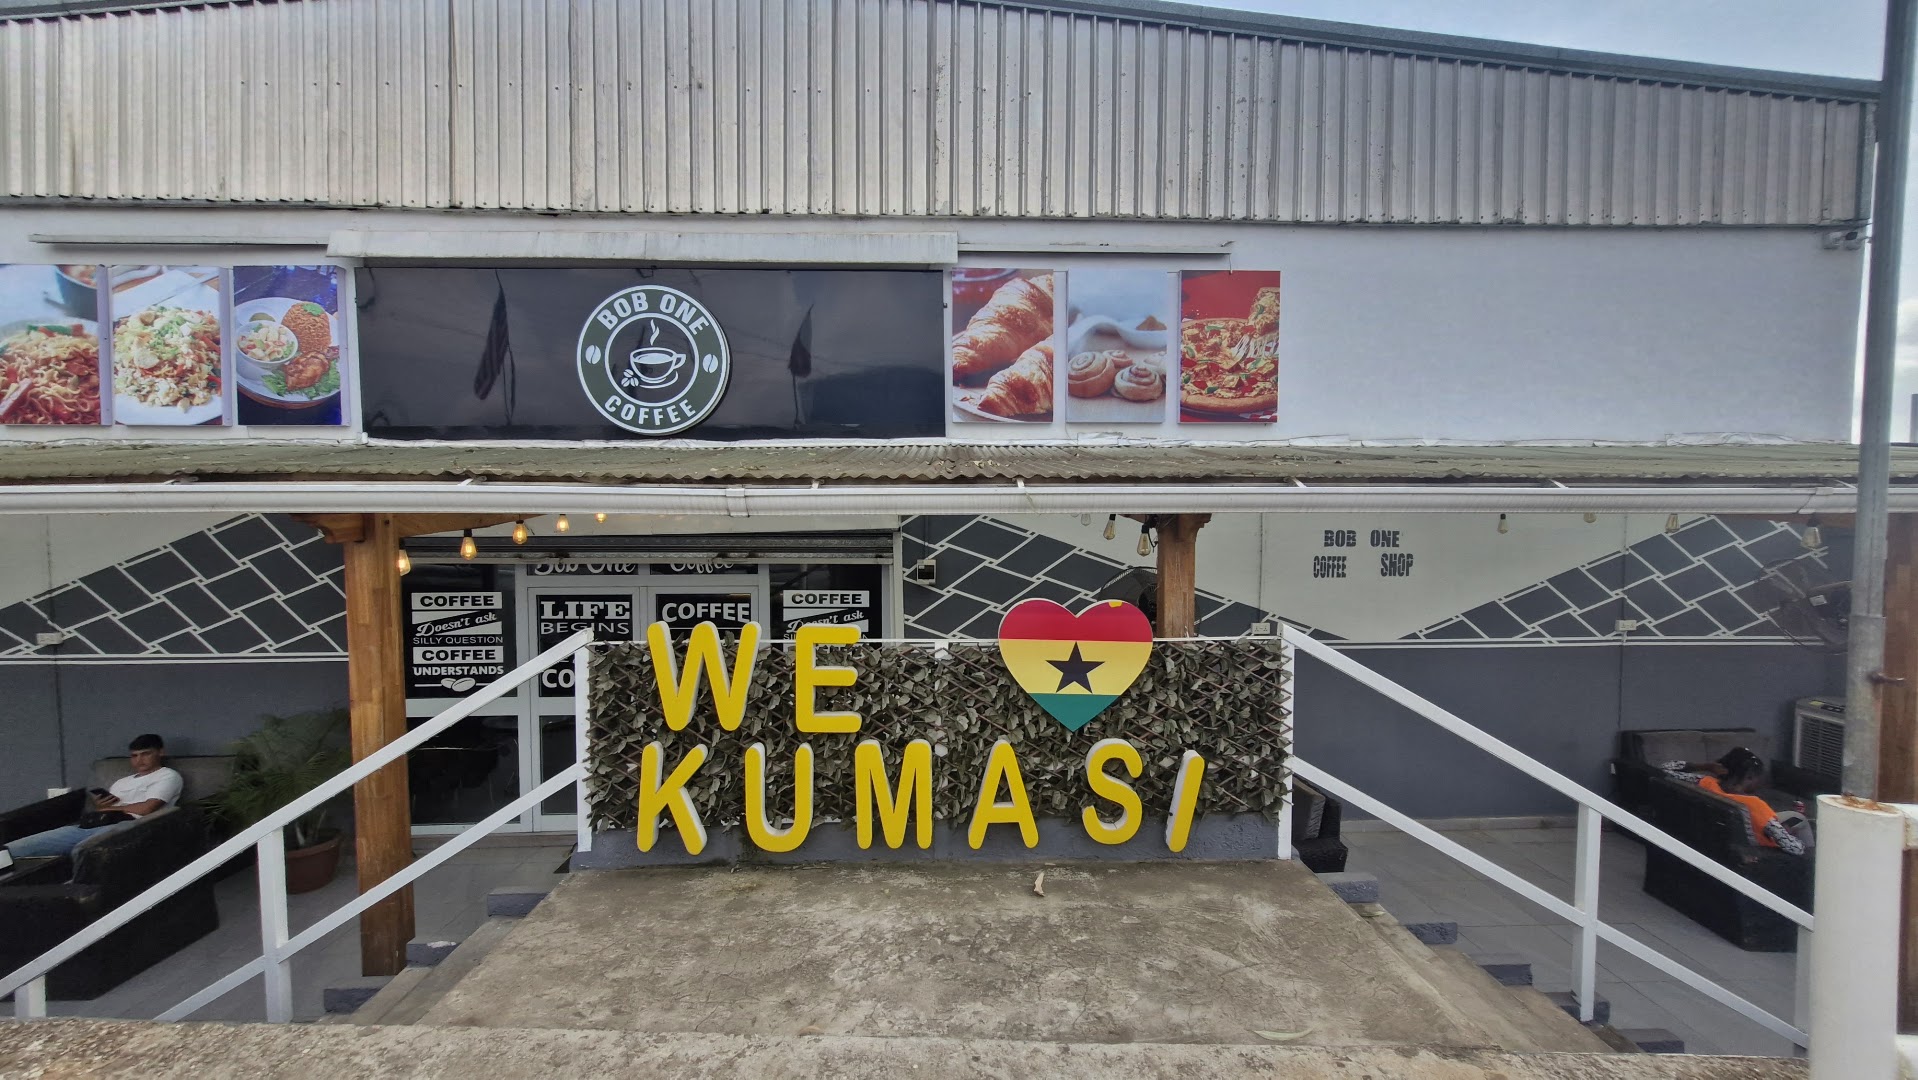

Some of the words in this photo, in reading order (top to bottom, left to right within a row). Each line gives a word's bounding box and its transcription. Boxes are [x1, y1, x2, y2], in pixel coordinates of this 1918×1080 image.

[597, 292, 649, 330] BOB
[659, 294, 709, 335] ONE
[605, 395, 696, 426] COFFEE
[1324, 529, 1357, 547] BOB
[1370, 529, 1400, 548] ONE
[1313, 555, 1347, 579] COFFEE
[1380, 553, 1414, 577] SHOP
[420, 595, 494, 607] COFFEE
[791, 593, 863, 605] COFFEE
[540, 601, 630, 620] LIFE
[661, 602, 751, 624] COFFEE
[843, 610, 865, 622] ask
[415, 617, 471, 637] Doesn't
[475, 612, 497, 624] ask
[540, 622, 630, 635] BEGINS
[412, 637, 443, 645] SILLY
[445, 636, 504, 644] QUESTION
[421, 649, 496, 661] COFFEE
[412, 666, 504, 676] UNDERSTANDS
[646, 620, 863, 734] WE
[636, 737, 1205, 857] KUMASI
